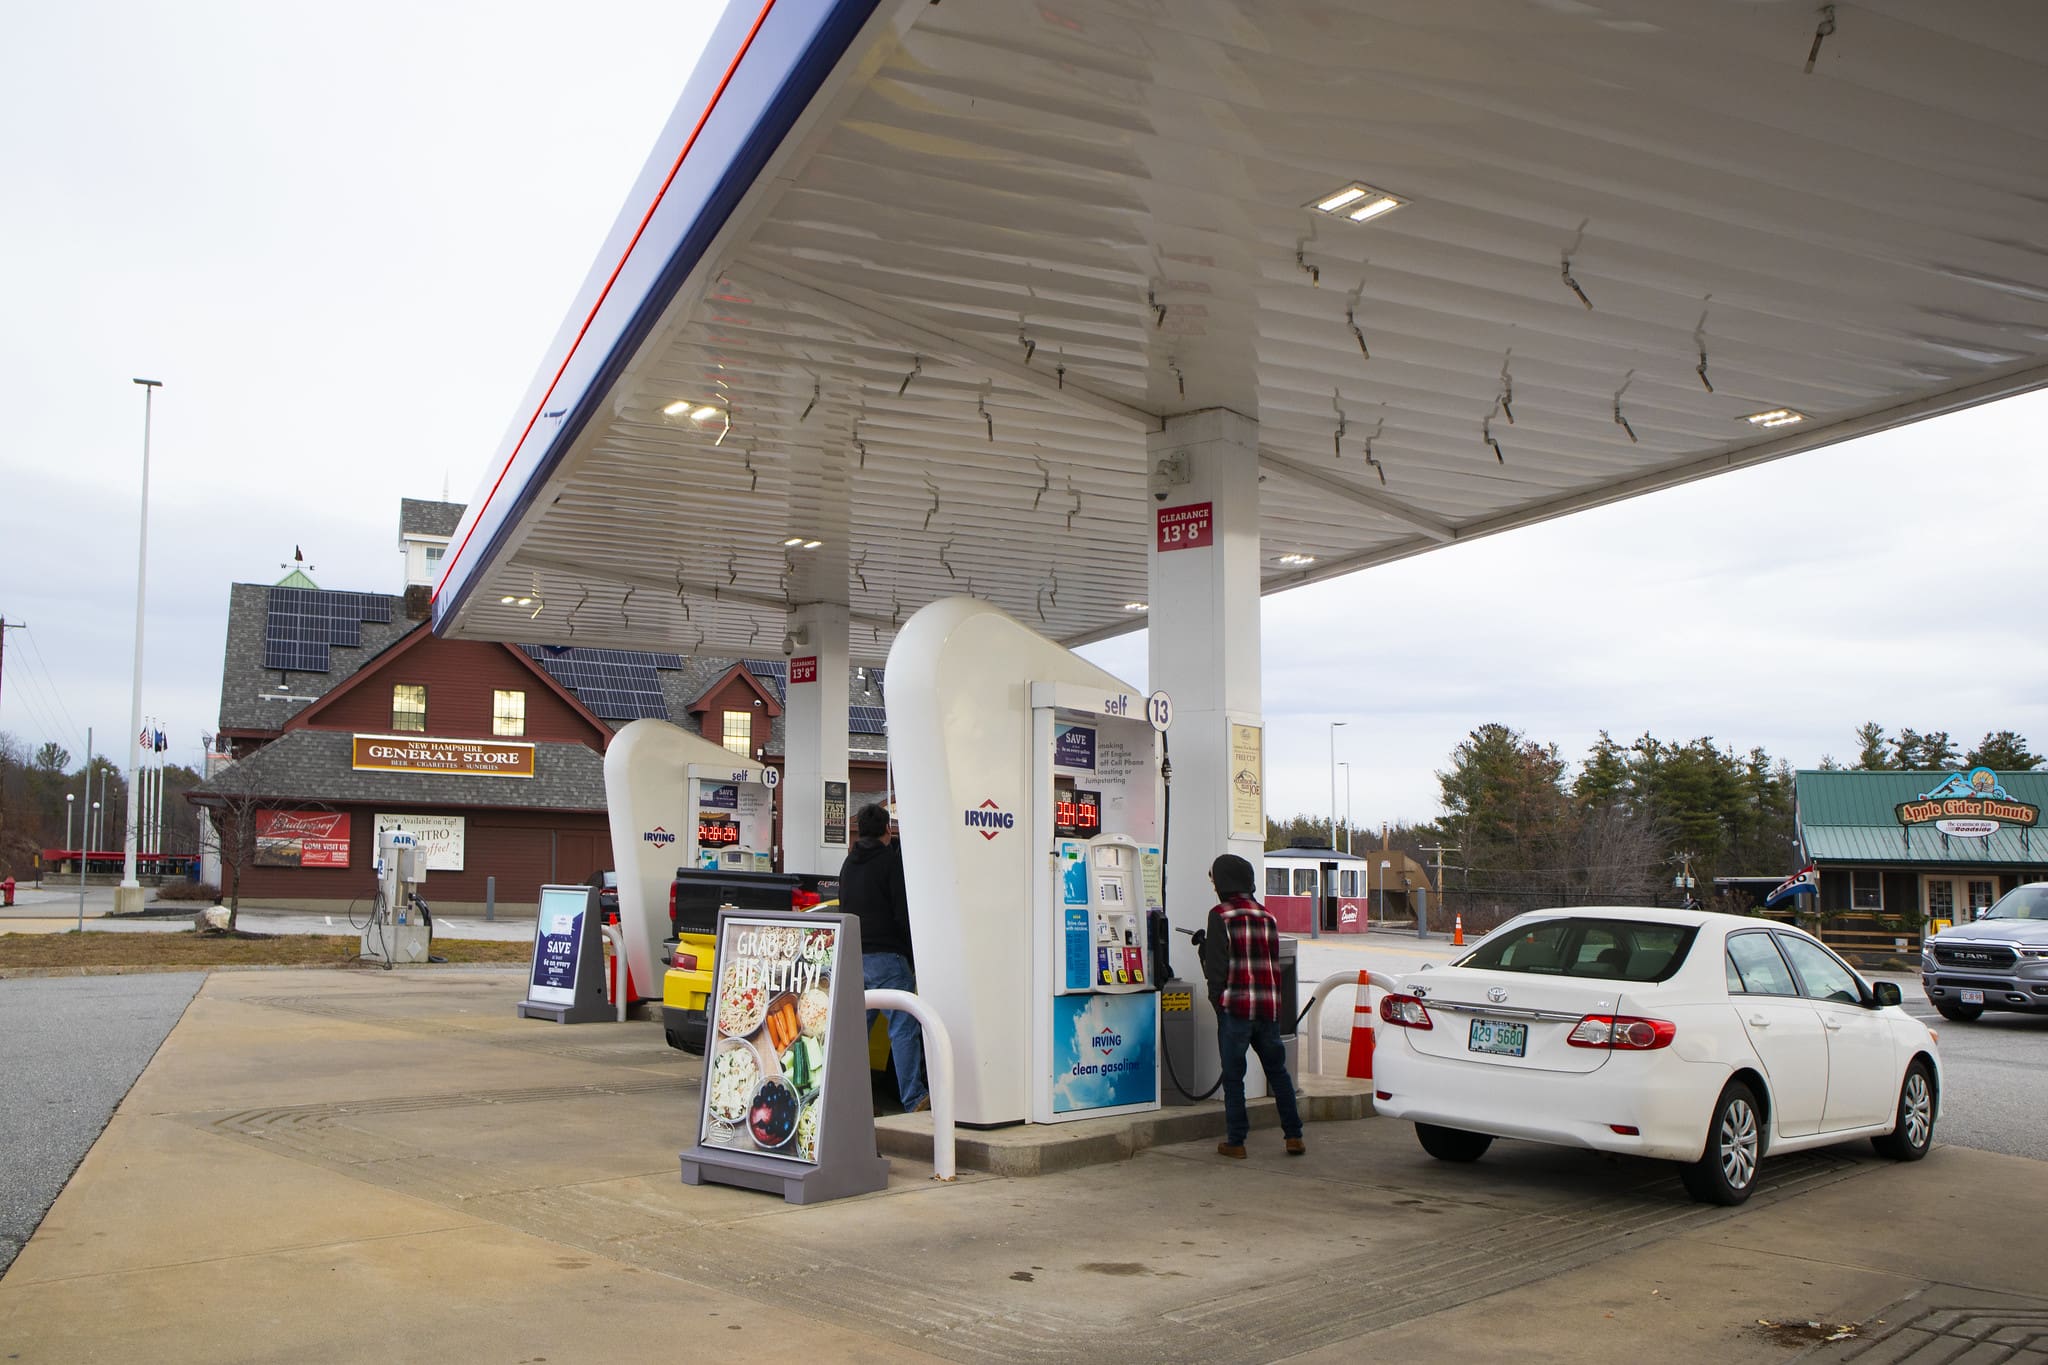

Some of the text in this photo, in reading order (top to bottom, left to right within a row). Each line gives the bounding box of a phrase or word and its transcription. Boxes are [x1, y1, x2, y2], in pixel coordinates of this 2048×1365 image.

[1160, 509, 1209, 523] CLEARANCE
[1105, 694, 1127, 715] self
[1153, 699, 1168, 724] 13
[1066, 733, 1086, 745] SAVE
[408, 742, 482, 752] NEW HAMPSHIRE
[1098, 743, 1123, 751] moking
[368, 745, 520, 764] GENERAL STORE
[416, 761, 458, 769] CIGARETTES
[732, 770, 748, 781] self
[766, 771, 776, 784] 15
[719, 788, 734, 796] SAVE
[826, 804, 845, 812] FAST
[1904, 800, 2033, 822] Apple Cider Donuts
[382, 816, 398, 824] Now
[401, 817, 432, 825] Available
[444, 818, 457, 828] Tap!
[965, 810, 1014, 829] IRVING
[393, 836, 411, 844] AIR
[644, 832, 675, 842] IRVING
[426, 842, 450, 856] offee!
[547, 940, 572, 954] SAVE
[738, 931, 826, 962] GRAB & GO
[1954, 952, 1988, 960] RAM
[736, 958, 822, 994] HEALTHY!
[1092, 1035, 1122, 1048] IRVING
[1472, 1026, 1522, 1046] 429 5680
[1072, 1062, 1098, 1076] clean
